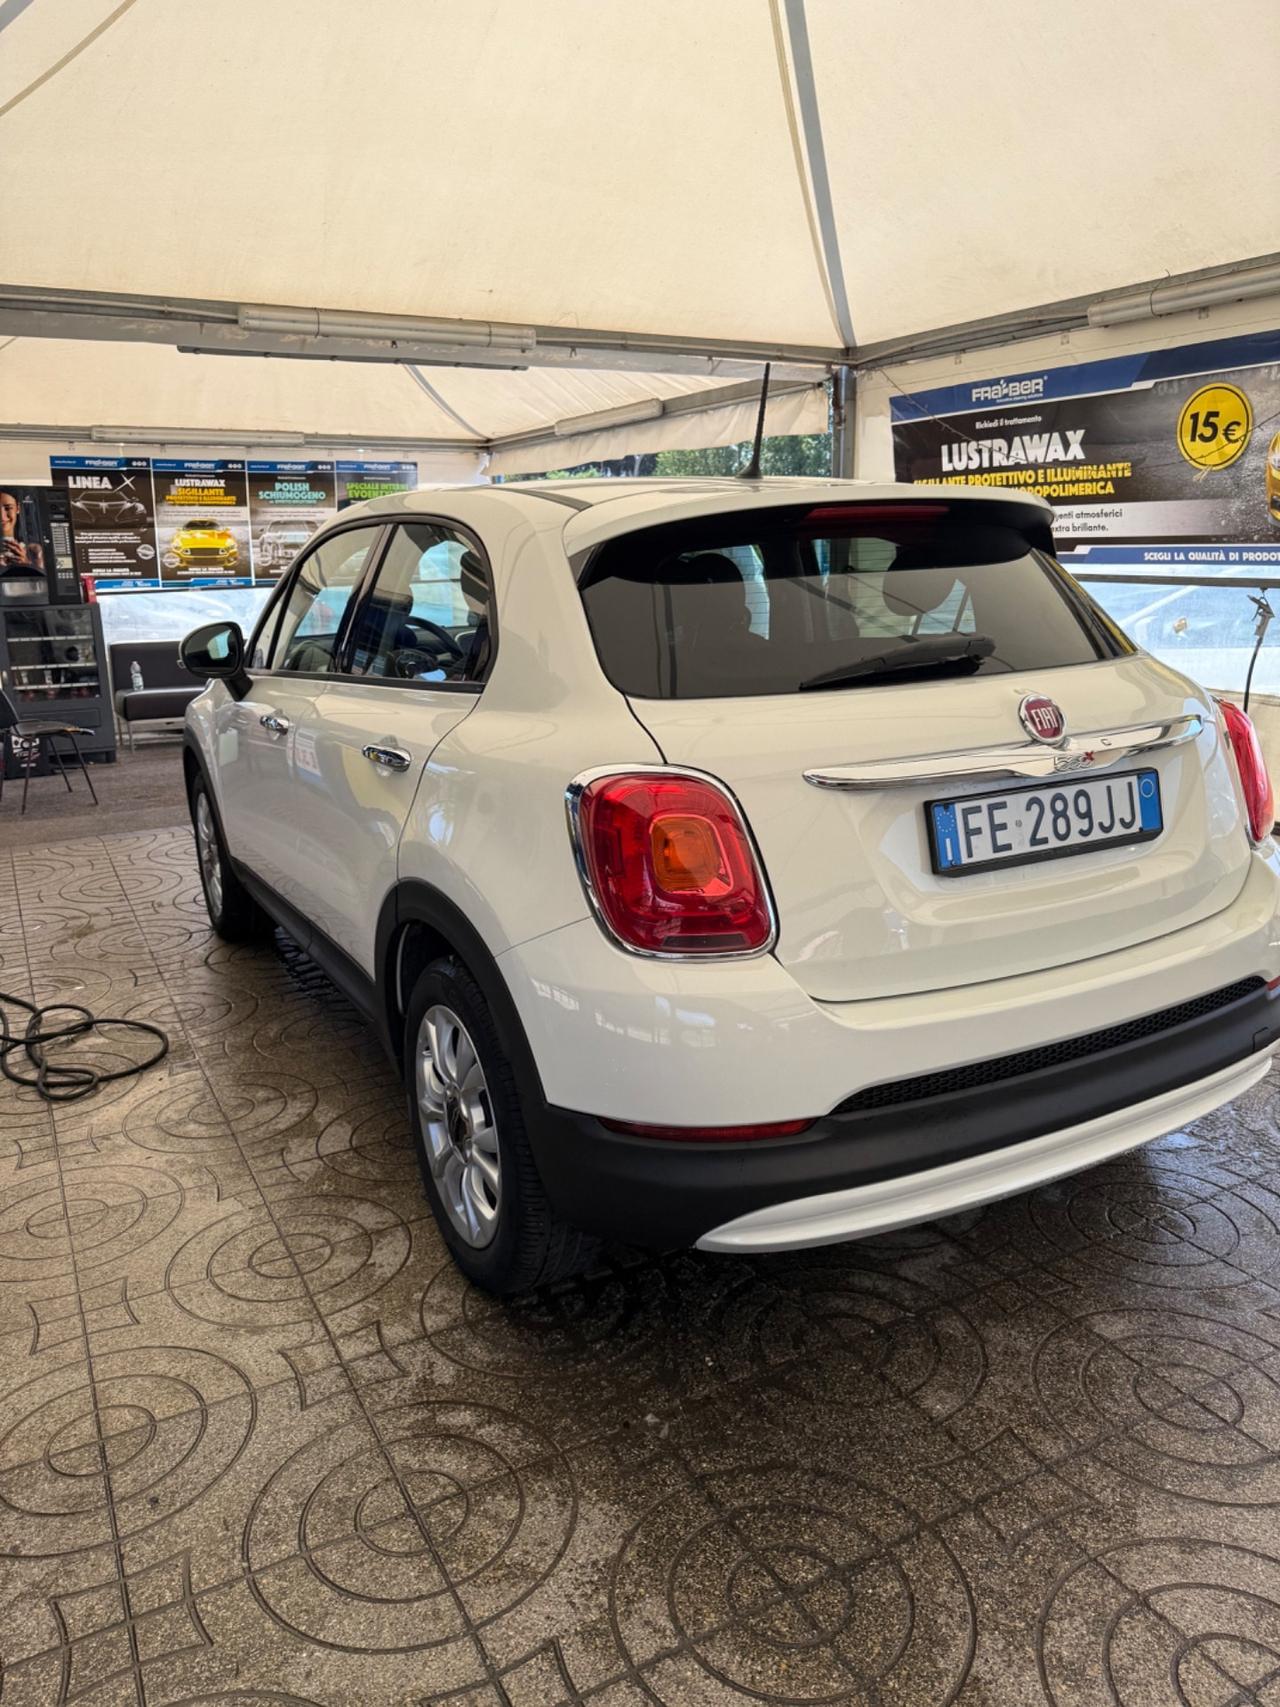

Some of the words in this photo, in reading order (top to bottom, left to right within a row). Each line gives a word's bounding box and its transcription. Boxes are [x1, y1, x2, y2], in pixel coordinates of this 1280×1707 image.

[975, 418, 999, 430] Richiedi
[1004, 414, 1042, 426] trattamento
[941, 428, 1086, 472] LUSTRAWAX
[968, 469, 1036, 487] PROTETTIVO
[1038, 468, 1045, 483] E
[1046, 462, 1132, 480] ILLUMINANTE
[67, 475, 113, 490] LINEA
[174, 478, 226, 488] LUSTRAWAX
[274, 482, 310, 492] POLISH
[258, 491, 326, 501] SCHIUMOGENO
[1075, 508, 1123, 519] atmosferici
[1143, 551, 1171, 561] SCEGLI
[1174, 552, 1186, 561] LA
[1188, 549, 1226, 561] QUALITÀ
[1229, 552, 1239, 561] DI
[1030, 706, 1058, 731] FIAT
